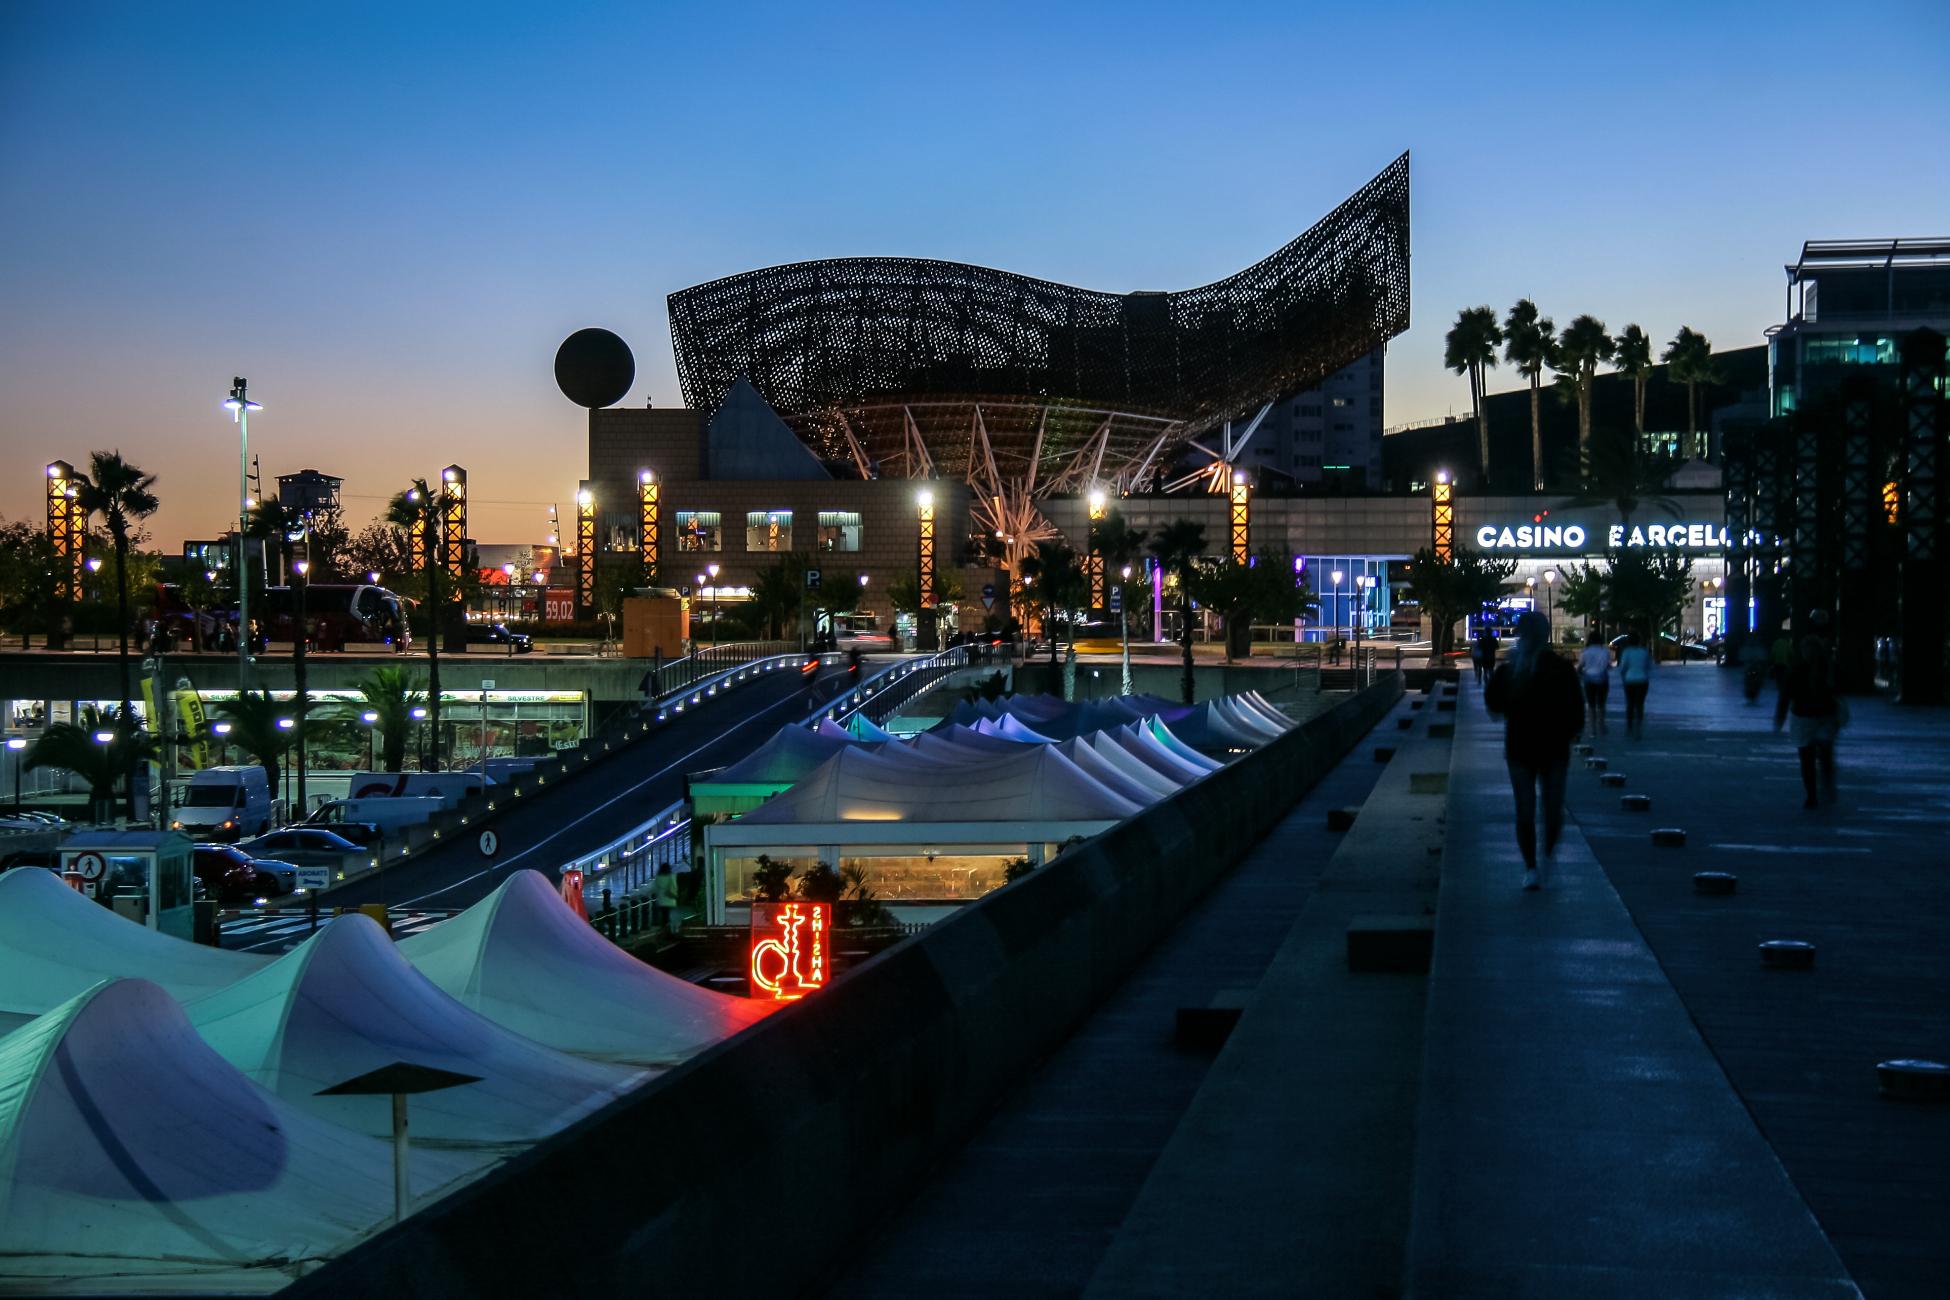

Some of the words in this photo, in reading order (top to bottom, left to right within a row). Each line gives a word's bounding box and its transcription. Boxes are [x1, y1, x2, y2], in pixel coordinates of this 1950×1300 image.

[1476, 525, 1585, 548] CASINO
[807, 570, 820, 585] P
[682, 586, 689, 594] P
[1112, 586, 1119, 595] P
[546, 600, 574, 622] 59,02
